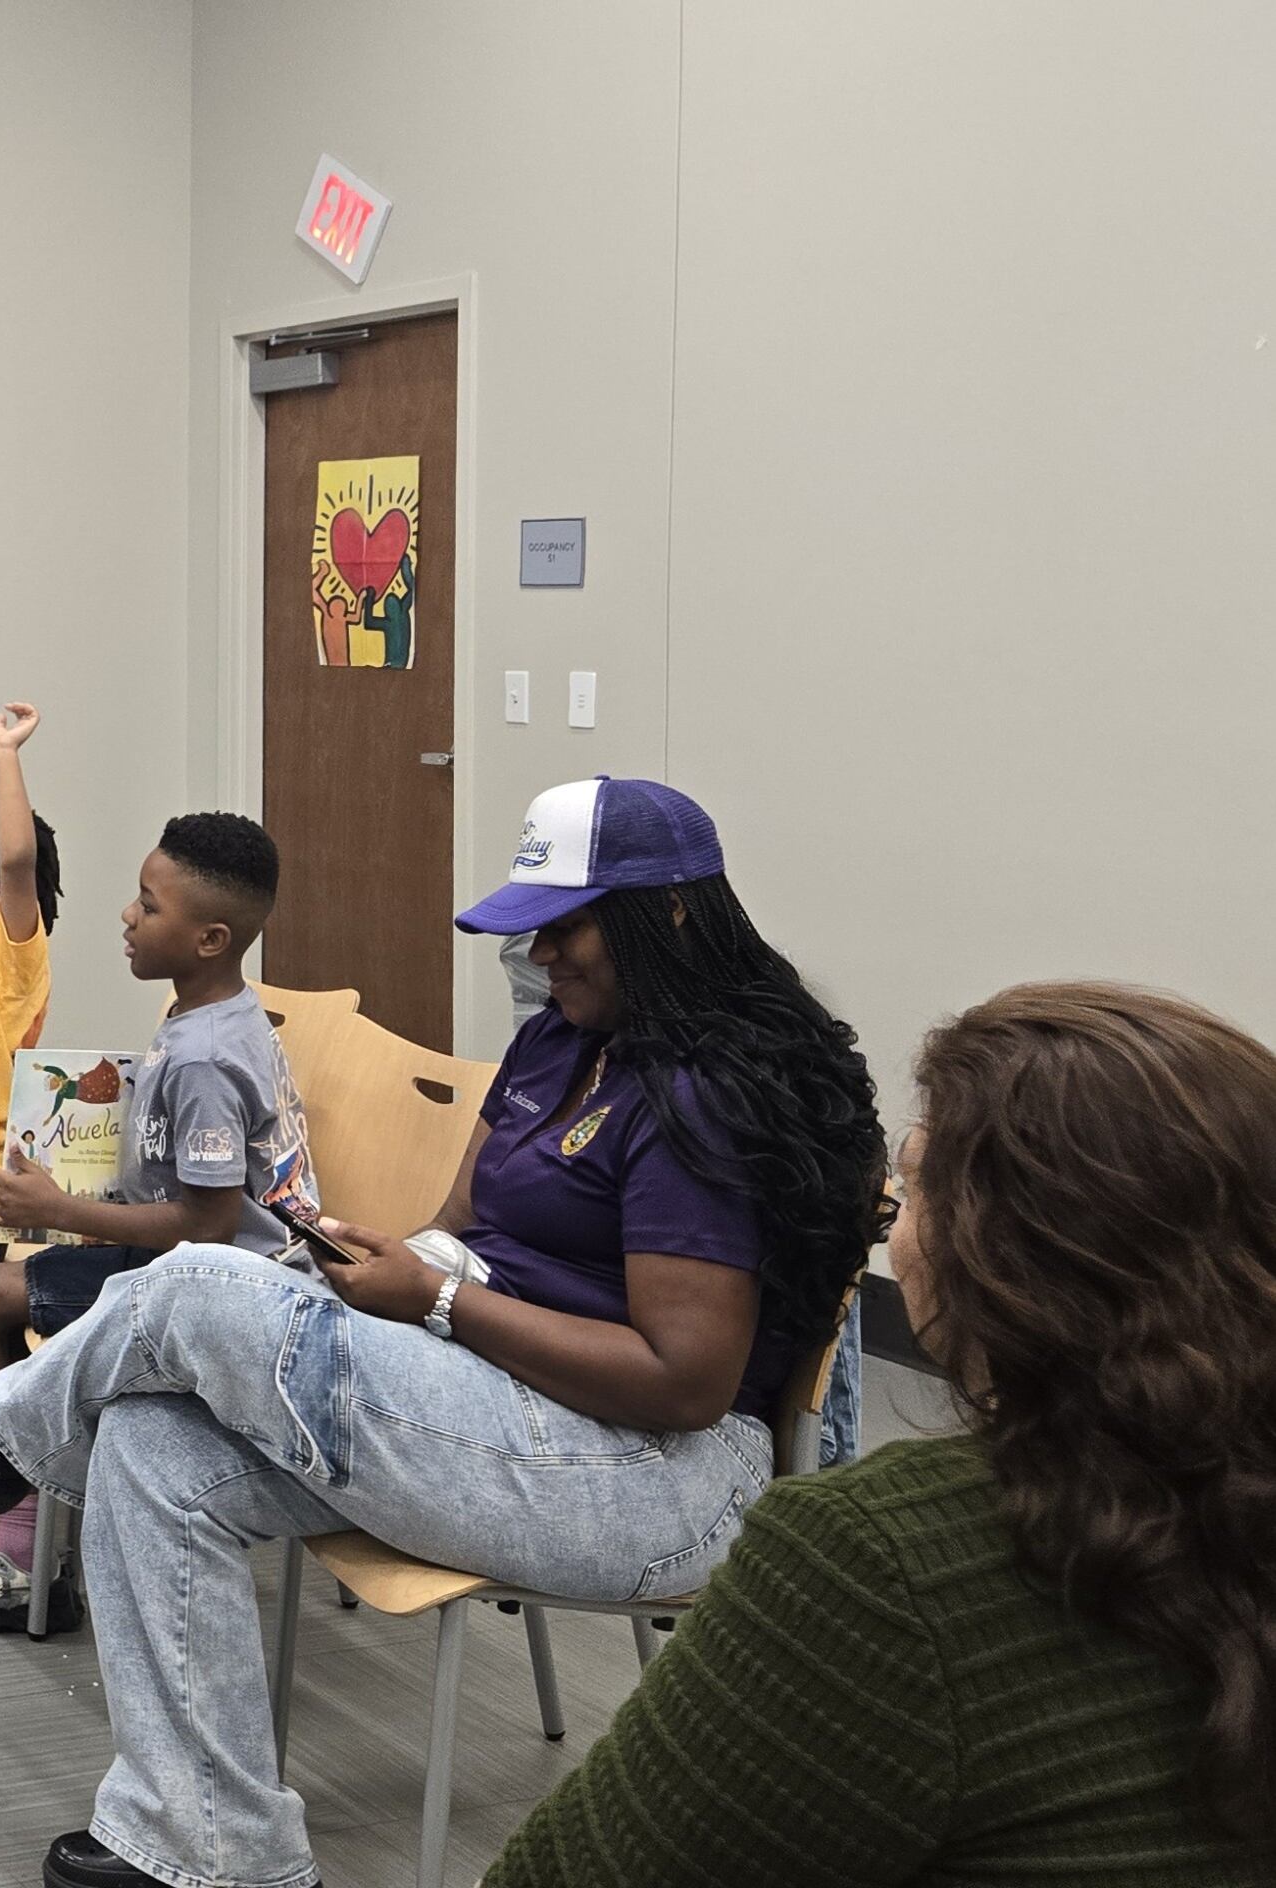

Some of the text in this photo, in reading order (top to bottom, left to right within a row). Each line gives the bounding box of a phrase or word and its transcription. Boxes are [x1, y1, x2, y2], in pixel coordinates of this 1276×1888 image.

[309, 174, 374, 264] EXIT
[528, 542, 576, 552] OCCUPANCY
[548, 553, 556, 563] 51
[41, 1107, 122, 1149] Abuela
